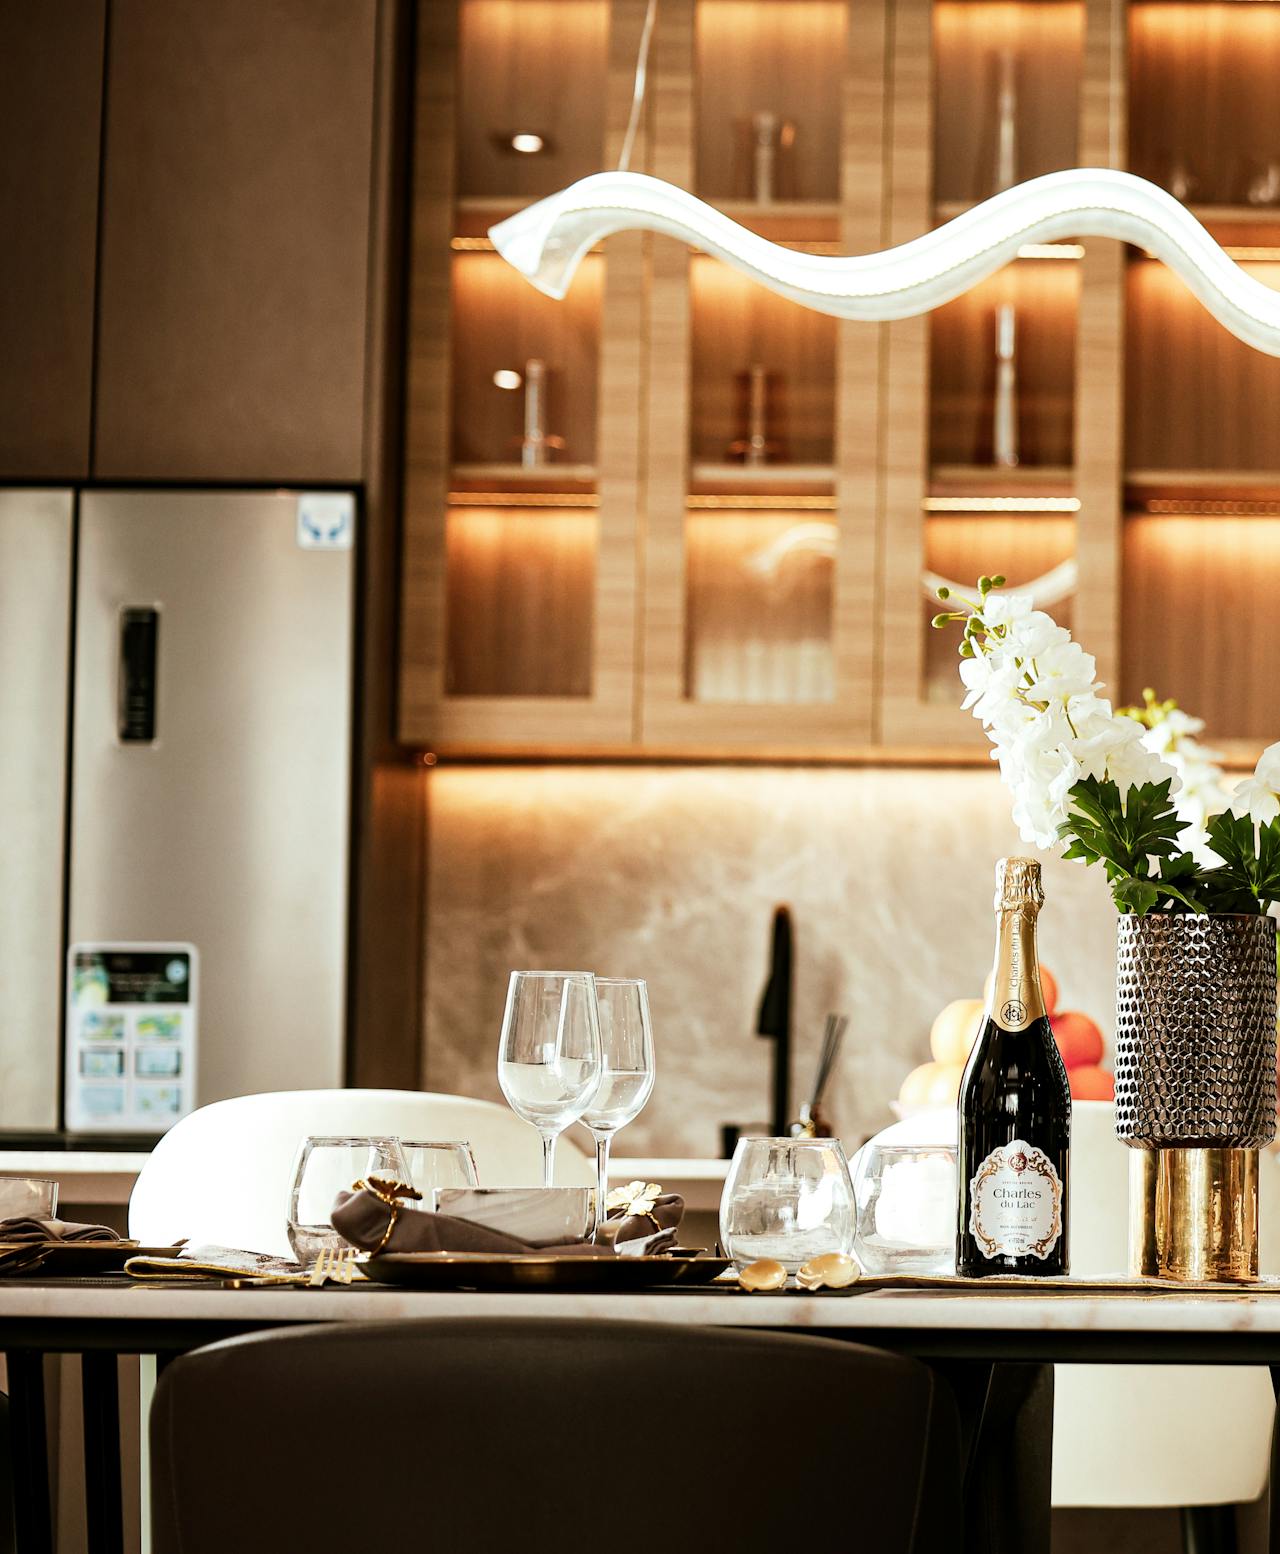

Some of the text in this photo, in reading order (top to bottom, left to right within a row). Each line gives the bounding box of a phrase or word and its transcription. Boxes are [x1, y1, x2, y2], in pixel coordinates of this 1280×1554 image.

[993, 1188, 1042, 1199] Charles
[1000, 1200, 1036, 1209] du Lac
